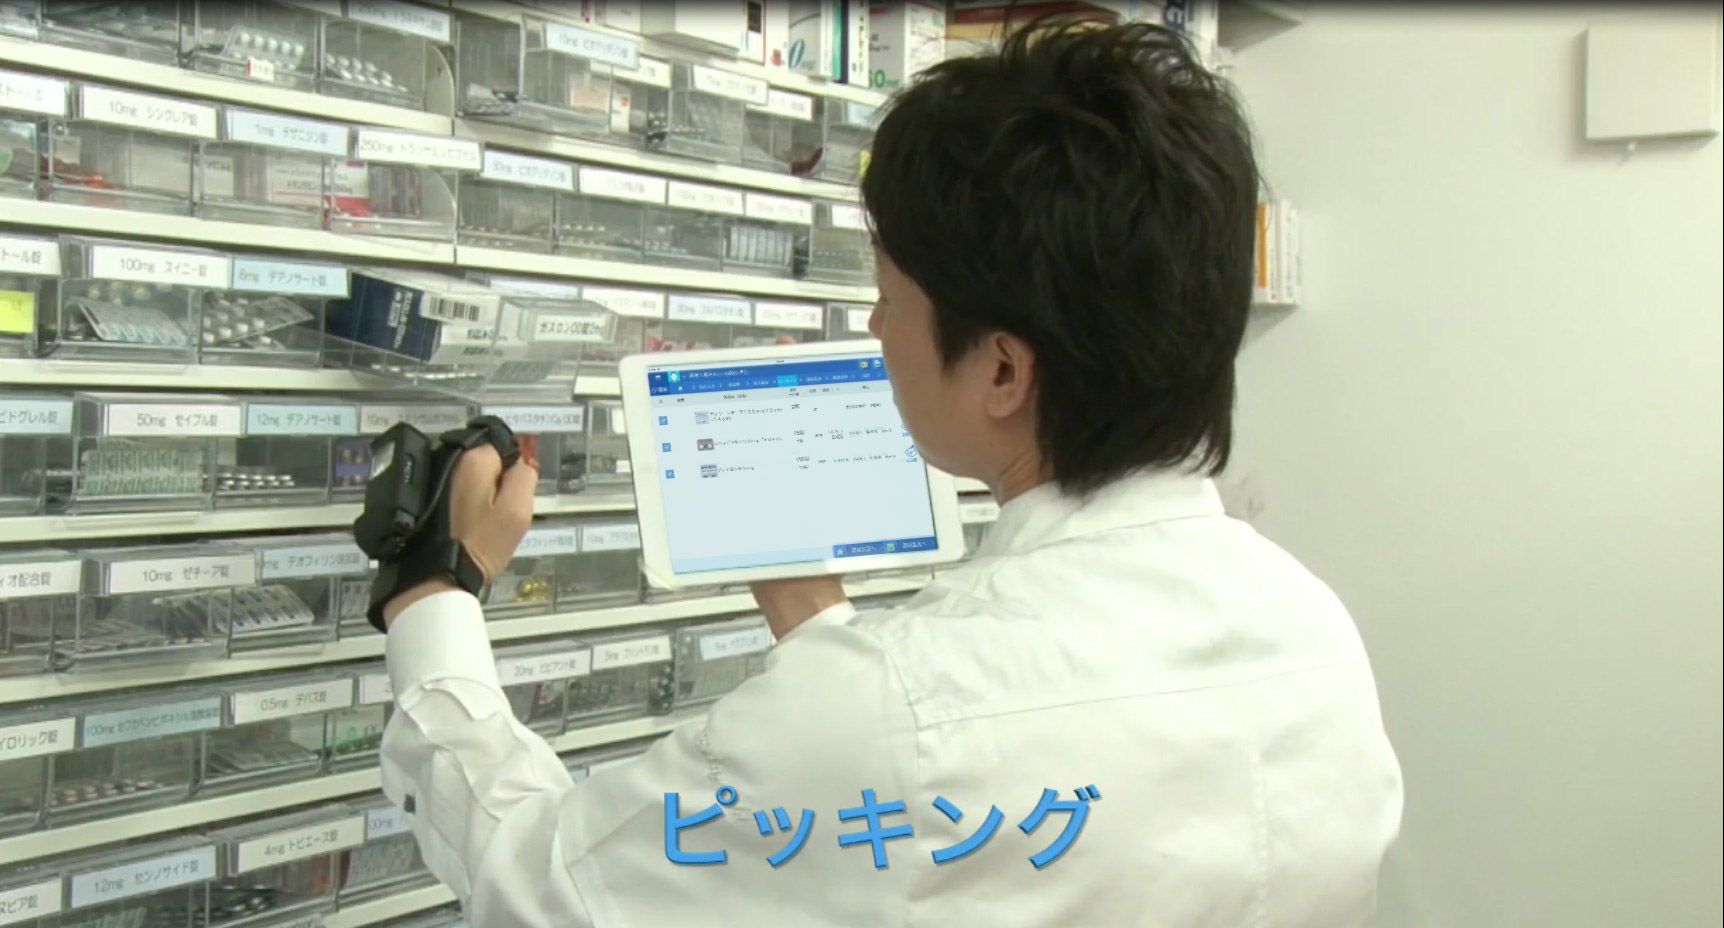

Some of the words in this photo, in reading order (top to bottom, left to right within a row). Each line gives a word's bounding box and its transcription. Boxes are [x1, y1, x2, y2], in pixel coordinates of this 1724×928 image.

[108, 100, 138, 118] 10mg
[119, 257, 156, 274] 100mg
[136, 412, 166, 428] 50mg
[256, 413, 280, 428] 12mg
[142, 570, 173, 583] 10mg
[182, 564, 230, 581] ゼチーア錠
[260, 696, 289, 713] 0.5mg
[264, 843, 285, 857] 4mg
[94, 877, 125, 895] 12mg
